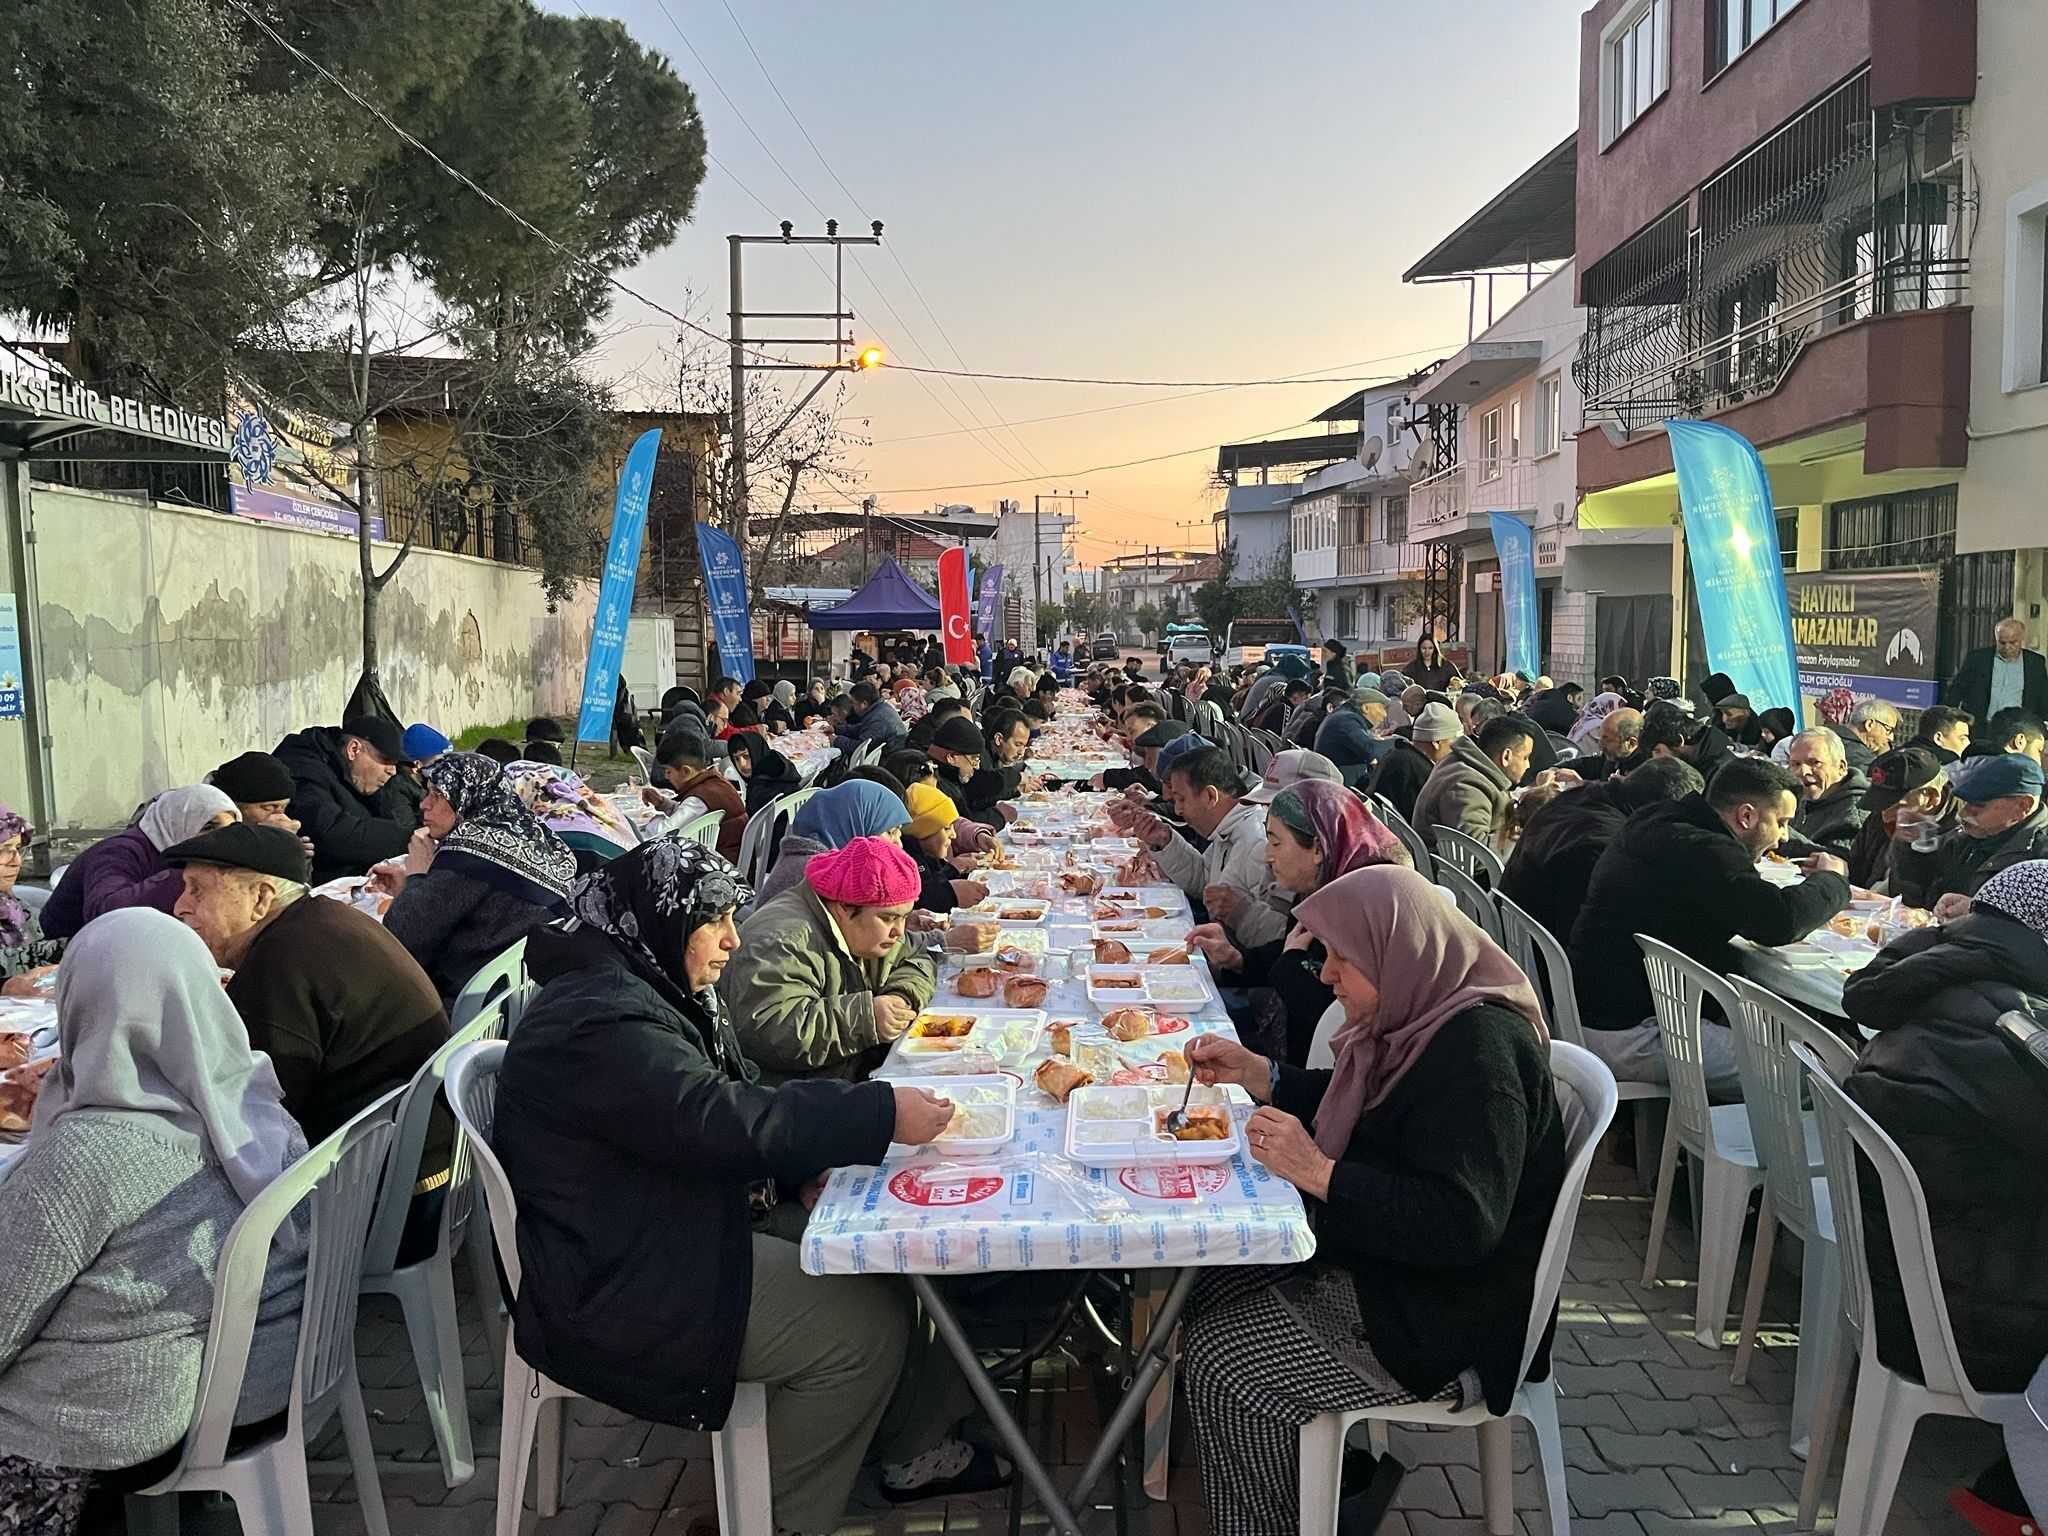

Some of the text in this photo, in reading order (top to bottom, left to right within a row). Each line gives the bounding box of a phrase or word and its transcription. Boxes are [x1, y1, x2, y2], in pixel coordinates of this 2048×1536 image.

[110, 394, 229, 449] BELEDİYESİ
[1800, 584, 1856, 613] HAYIRLI
[1792, 617, 1878, 648] AMAZANLAR
[1799, 674, 1853, 688] ZLEM ÇERÇİOĞLU
[948, 1187, 965, 1198] 24
